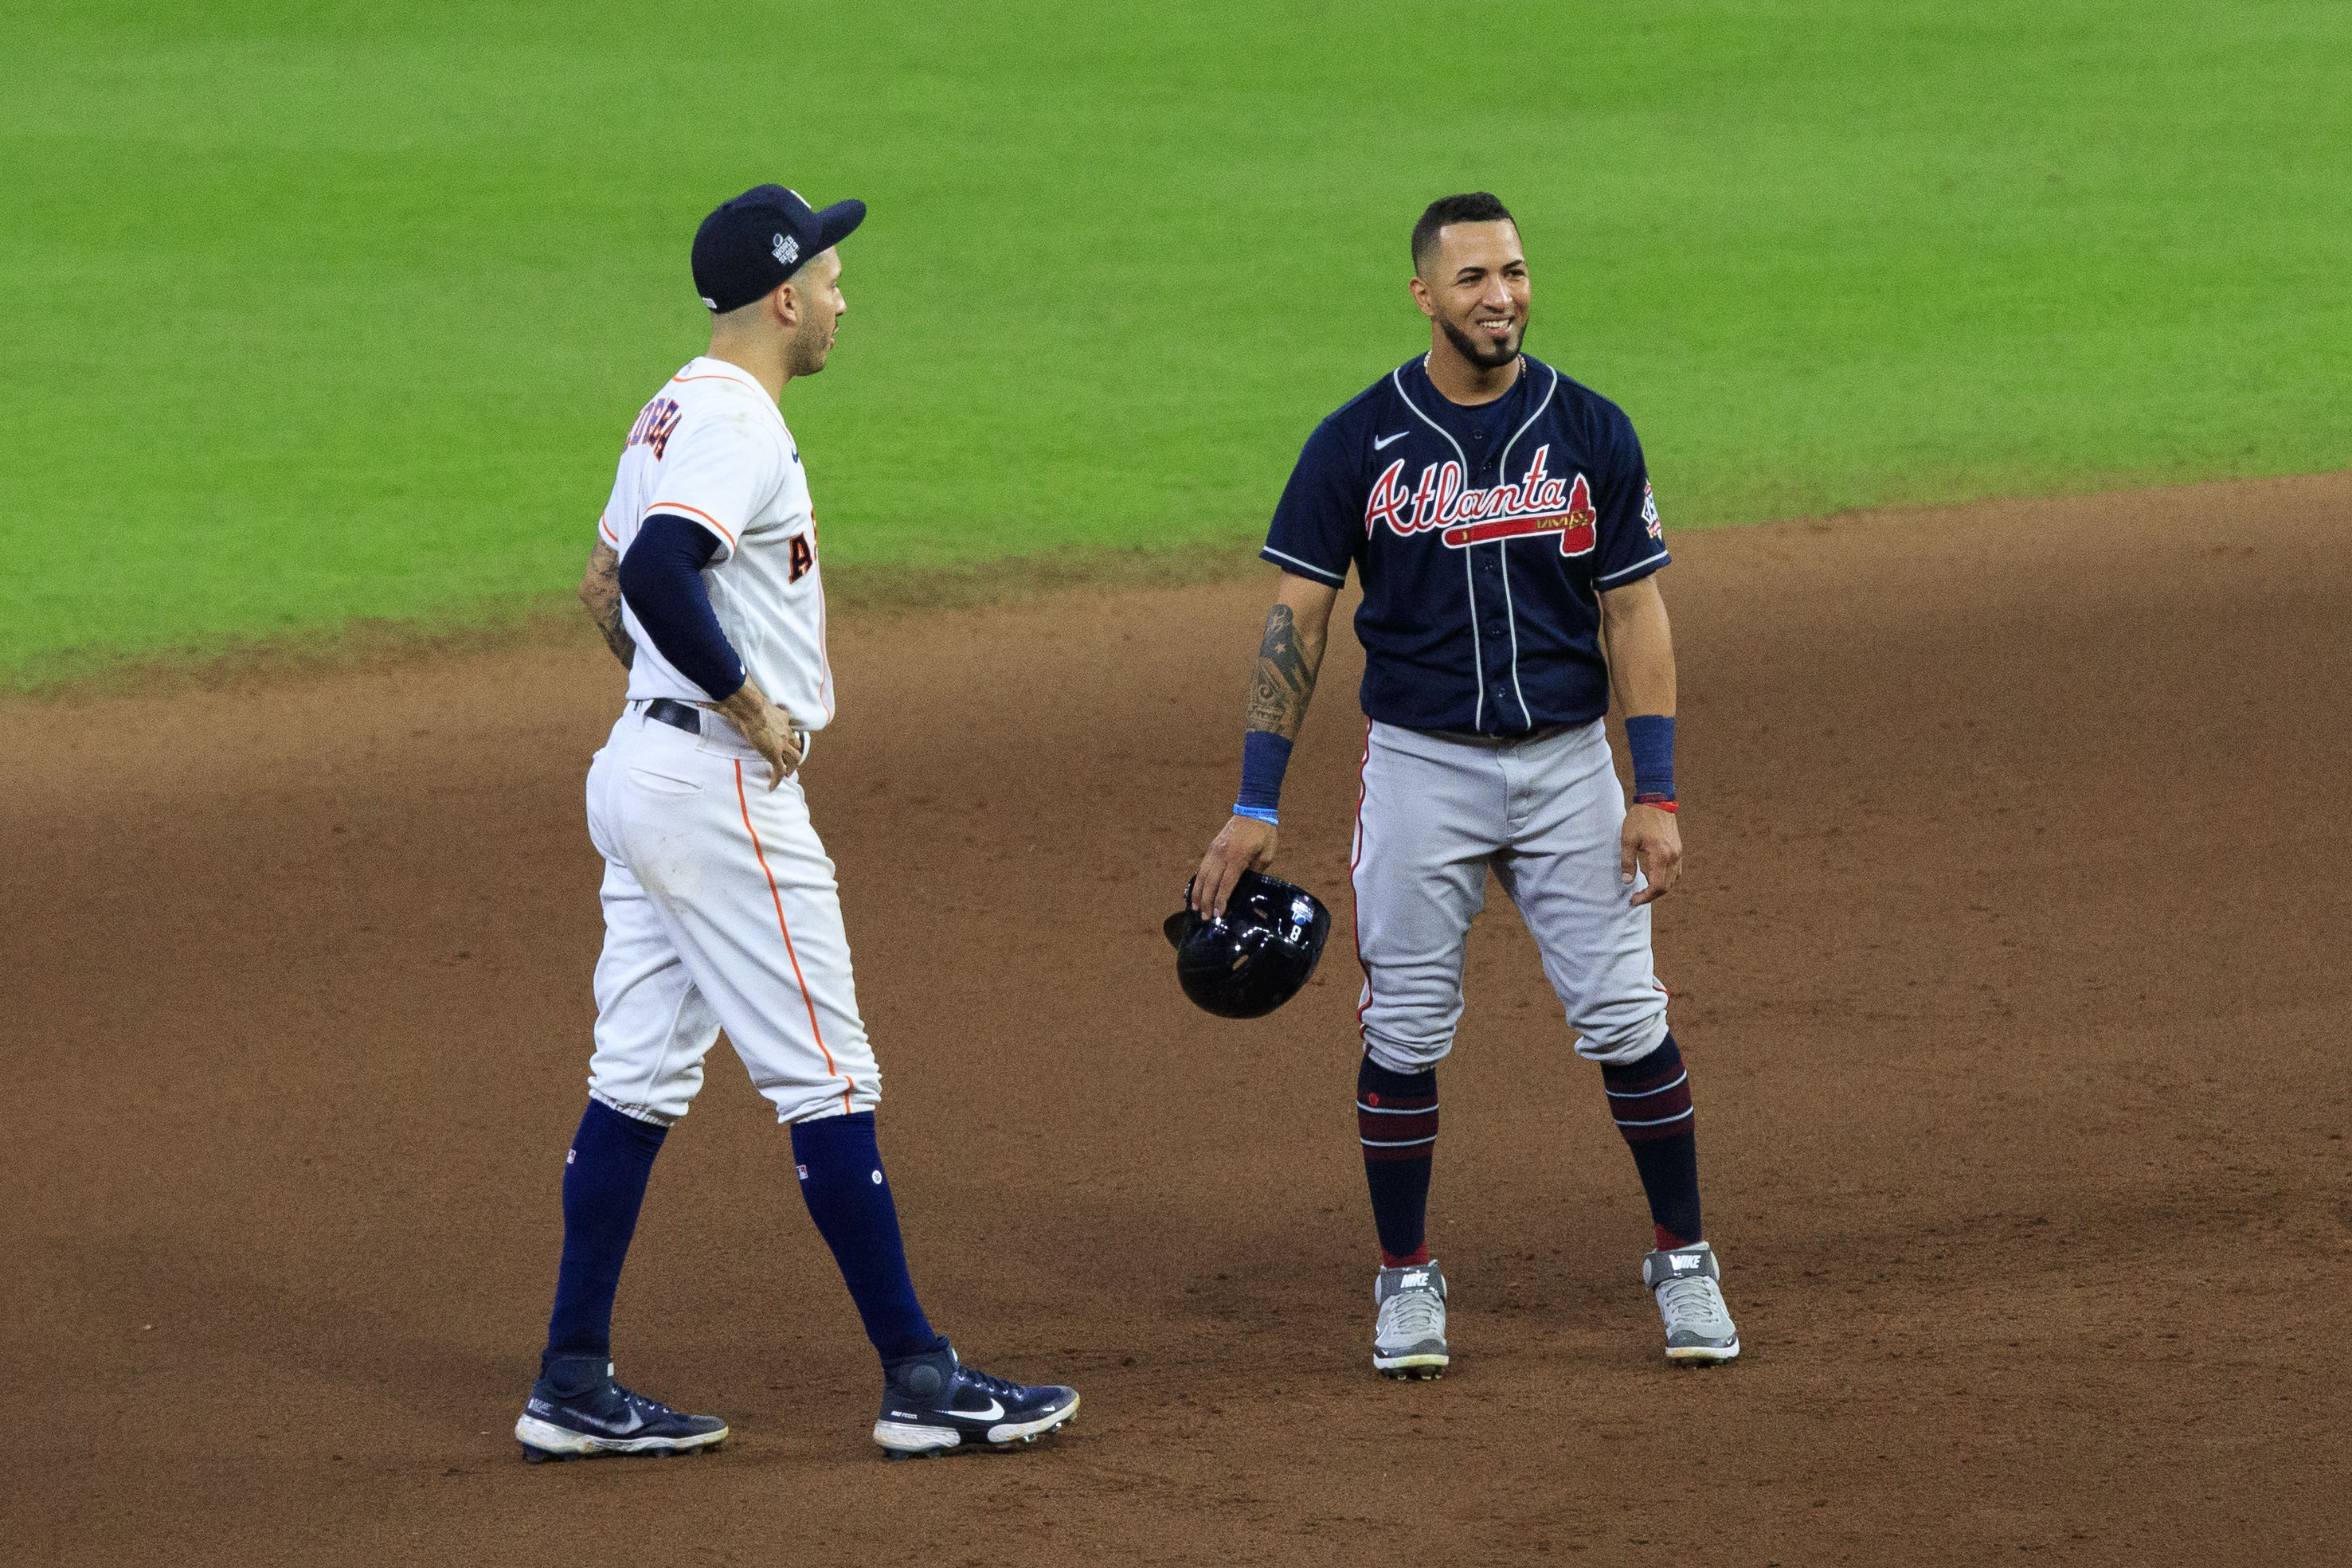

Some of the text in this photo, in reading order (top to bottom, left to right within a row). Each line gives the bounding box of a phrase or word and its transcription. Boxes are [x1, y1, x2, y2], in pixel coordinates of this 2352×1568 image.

[773, 236, 794, 258] WORLD
[778, 241, 799, 264] SERIES
[1365, 444, 1567, 540] Atlanta
[1290, 925, 1301, 941] 8
[1669, 1254, 1701, 1269] NIKE
[1400, 1273, 1430, 1288] NIKE
